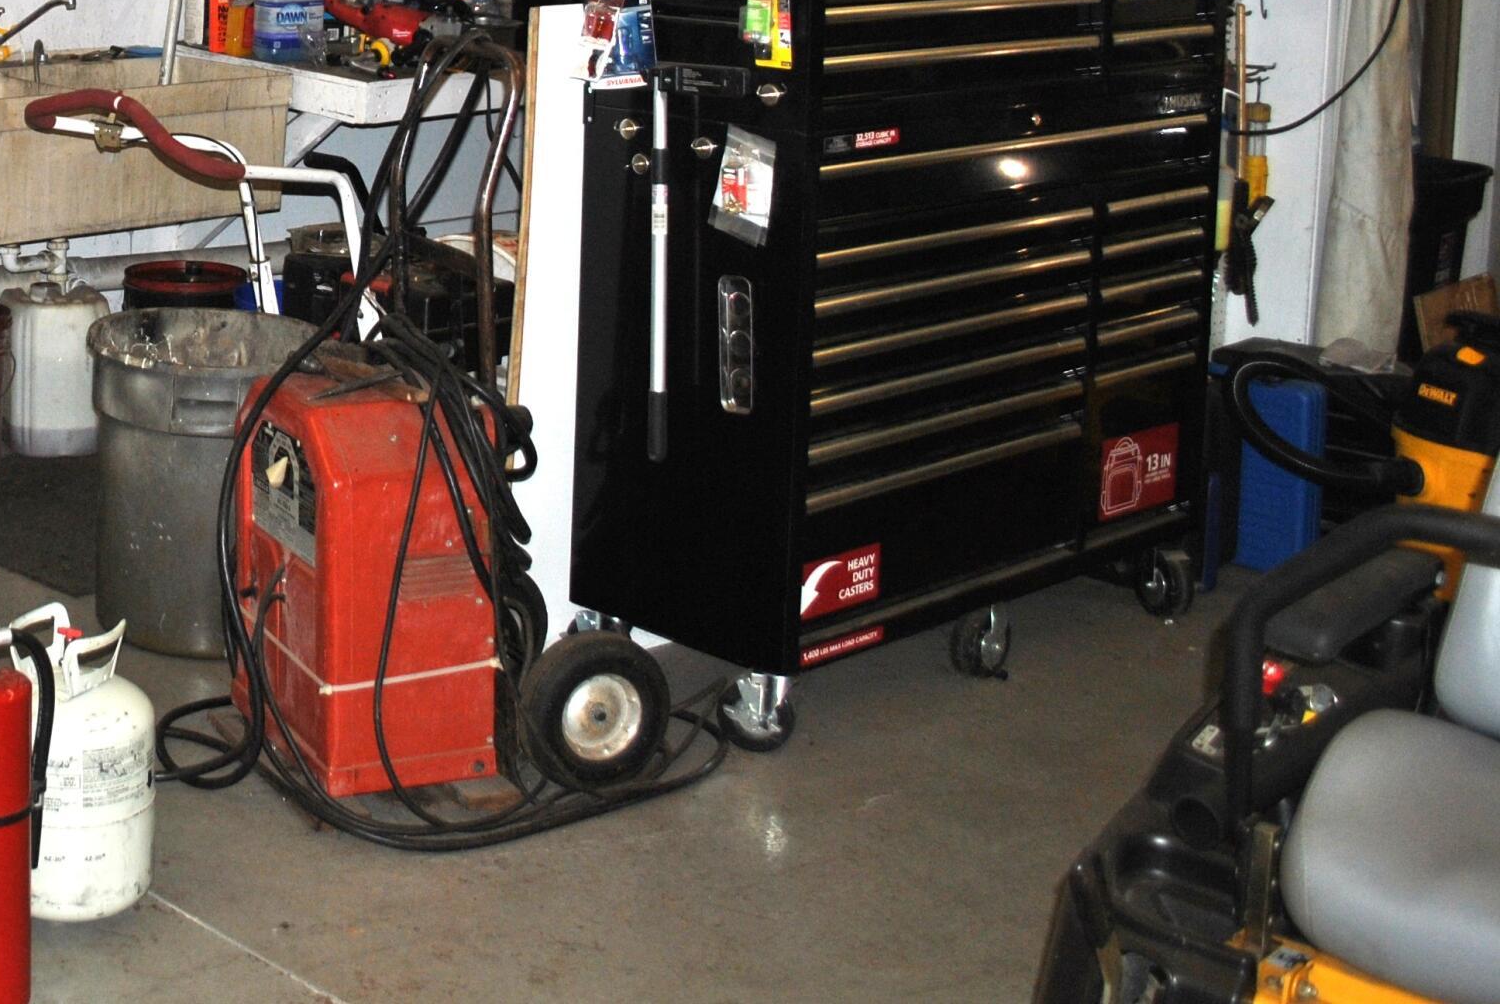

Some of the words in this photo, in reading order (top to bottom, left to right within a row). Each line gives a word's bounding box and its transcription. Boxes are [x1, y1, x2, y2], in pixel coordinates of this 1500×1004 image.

[276, 11, 308, 25] DAWN
[606, 75, 645, 87] SYLVANIA
[1168, 94, 1202, 109] HUSKY
[1418, 382, 1457, 406] DEWALT
[1146, 453, 1160, 472] 13
[1160, 453, 1172, 468] IN
[847, 553, 876, 572] HEAVY
[852, 567, 876, 584] DUTY
[838, 580, 875, 600] CASTERS
